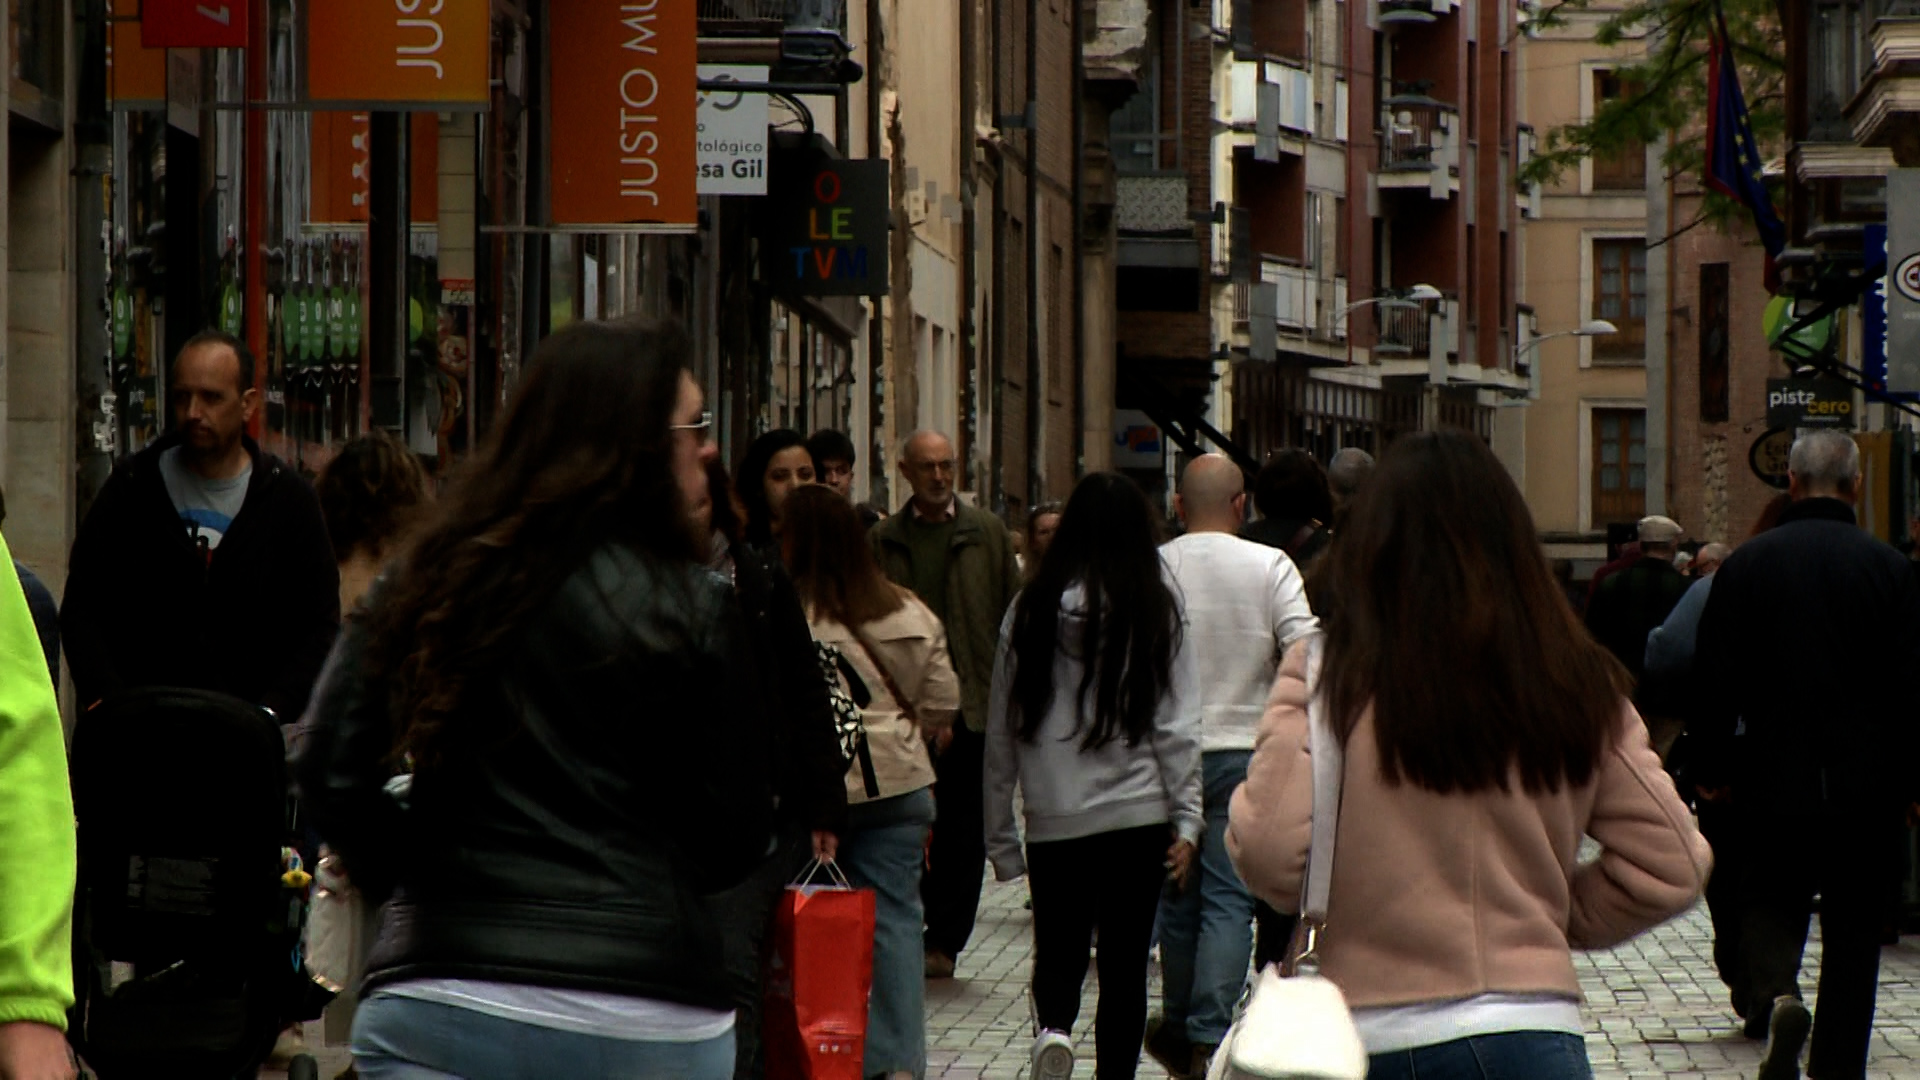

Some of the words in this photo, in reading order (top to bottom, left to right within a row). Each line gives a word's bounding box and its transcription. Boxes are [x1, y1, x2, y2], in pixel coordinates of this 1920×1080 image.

[619, 67, 659, 206] JUSTO
[731, 159, 762, 179] Gil
[813, 169, 842, 205] O
[809, 207, 854, 241] LE
[789, 246, 868, 280] TVM
[1807, 400, 1851, 415] cero
